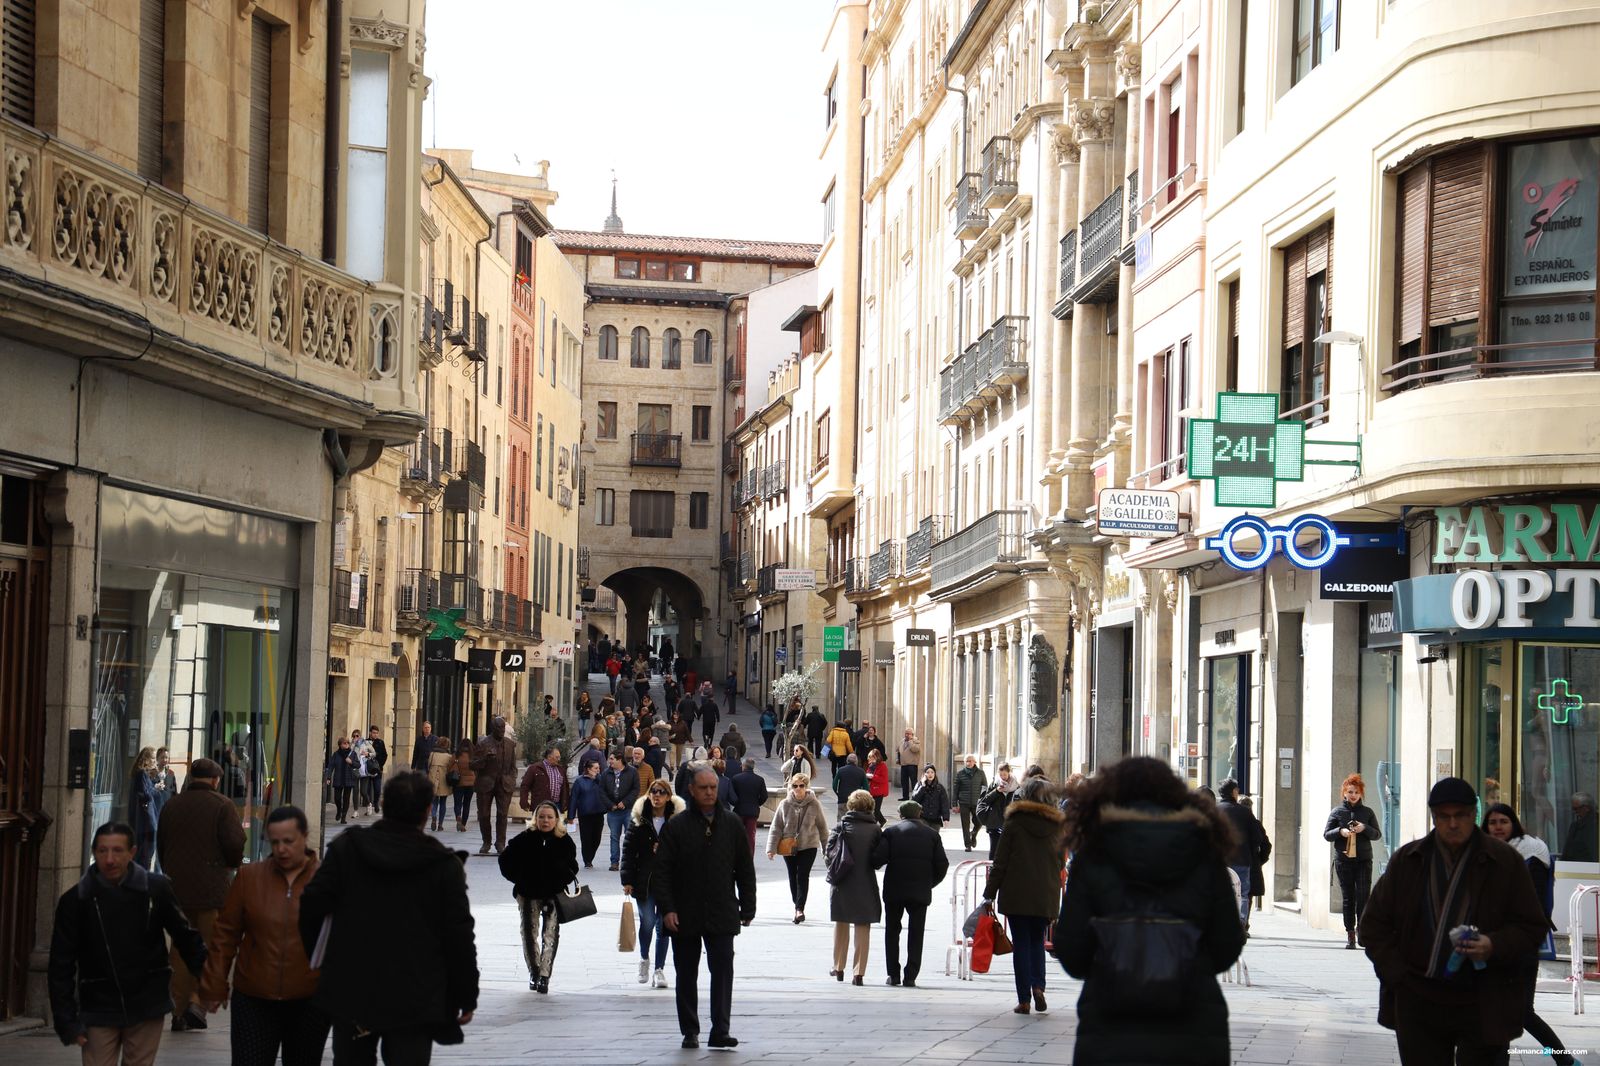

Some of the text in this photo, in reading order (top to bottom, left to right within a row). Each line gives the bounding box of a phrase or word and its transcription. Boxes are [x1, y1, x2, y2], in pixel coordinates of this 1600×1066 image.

[1529, 257, 1575, 272] ESPAÑOL
[1514, 271, 1590, 286] EXTRANJEROS
[1535, 313, 1550, 325] 923
[1554, 313, 1563, 324] 21
[1214, 435, 1275, 463] 24H
[1108, 493, 1170, 507] ACADEMIA
[1114, 507, 1164, 521] GALILEO
[1119, 522, 1156, 530] FACULTADES
[1324, 583, 1394, 593] CALZEDONIA
[505, 654, 523, 667] JD
